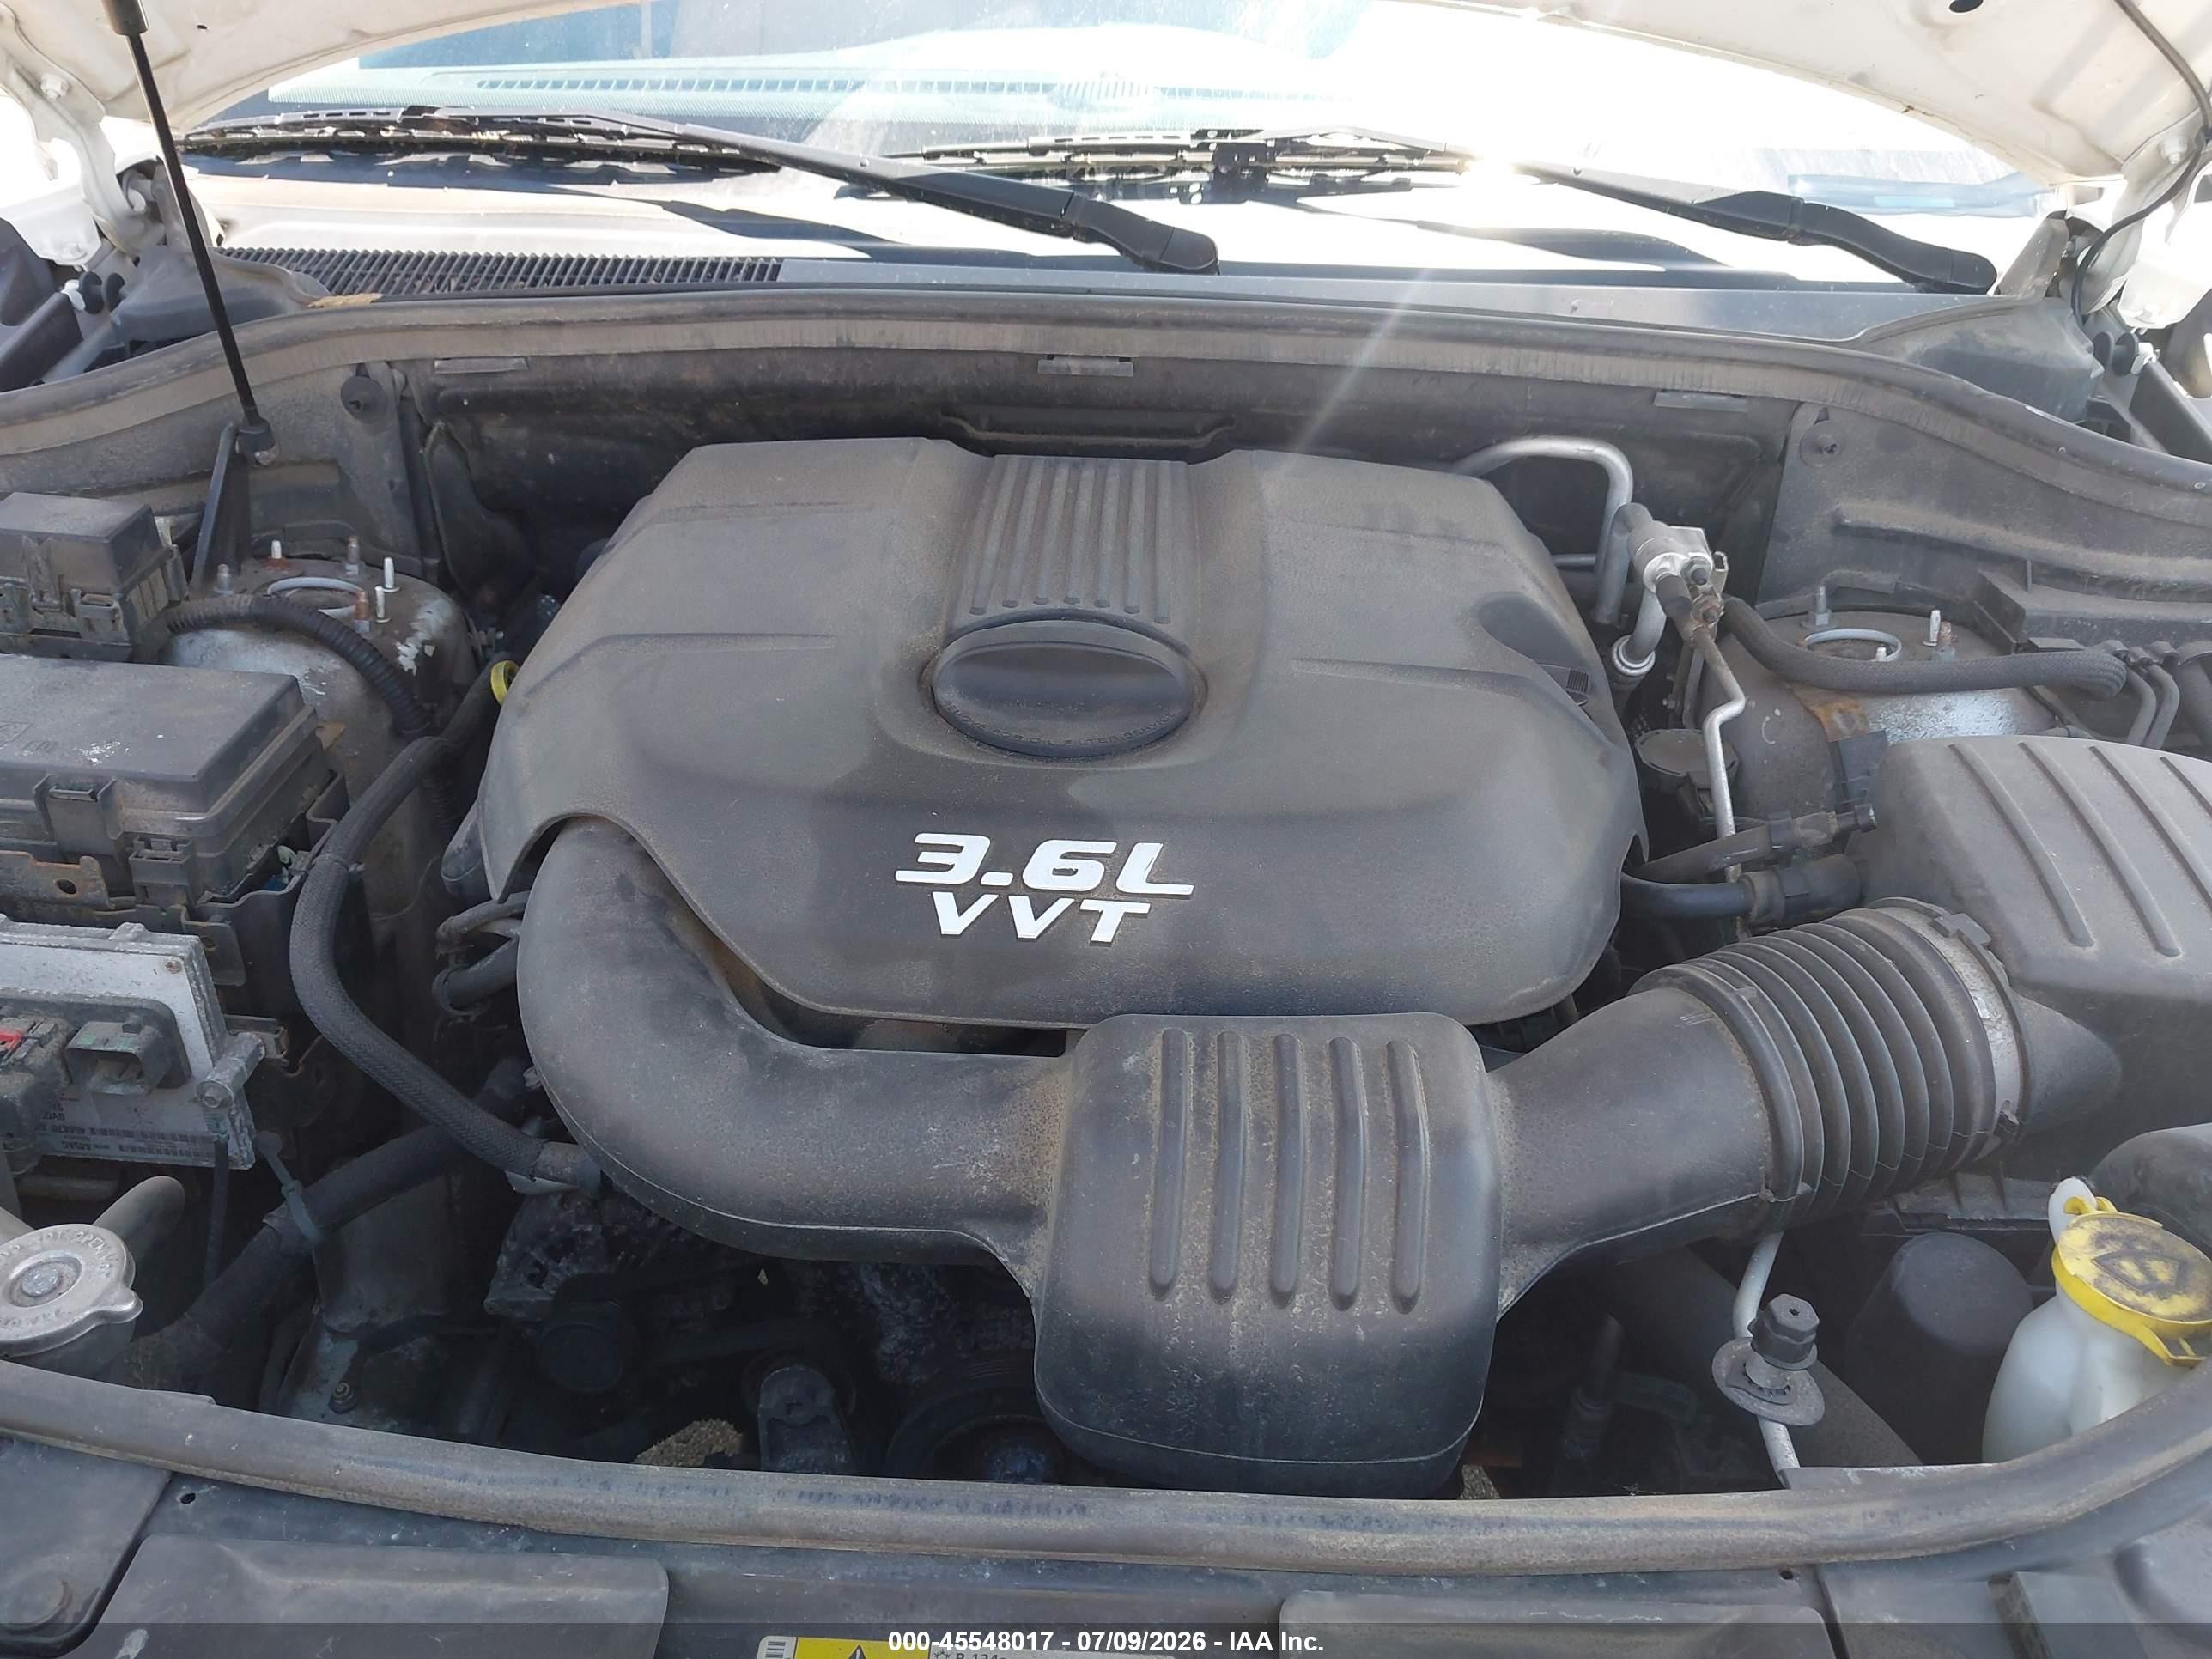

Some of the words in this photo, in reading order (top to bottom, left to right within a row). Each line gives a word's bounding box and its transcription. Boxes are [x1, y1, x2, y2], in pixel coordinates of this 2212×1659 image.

[943, 700, 990, 729] REMOVE
[993, 729, 1024, 739] FOR
[895, 833, 1194, 896] 3.6L
[932, 891, 1151, 943] VVT
